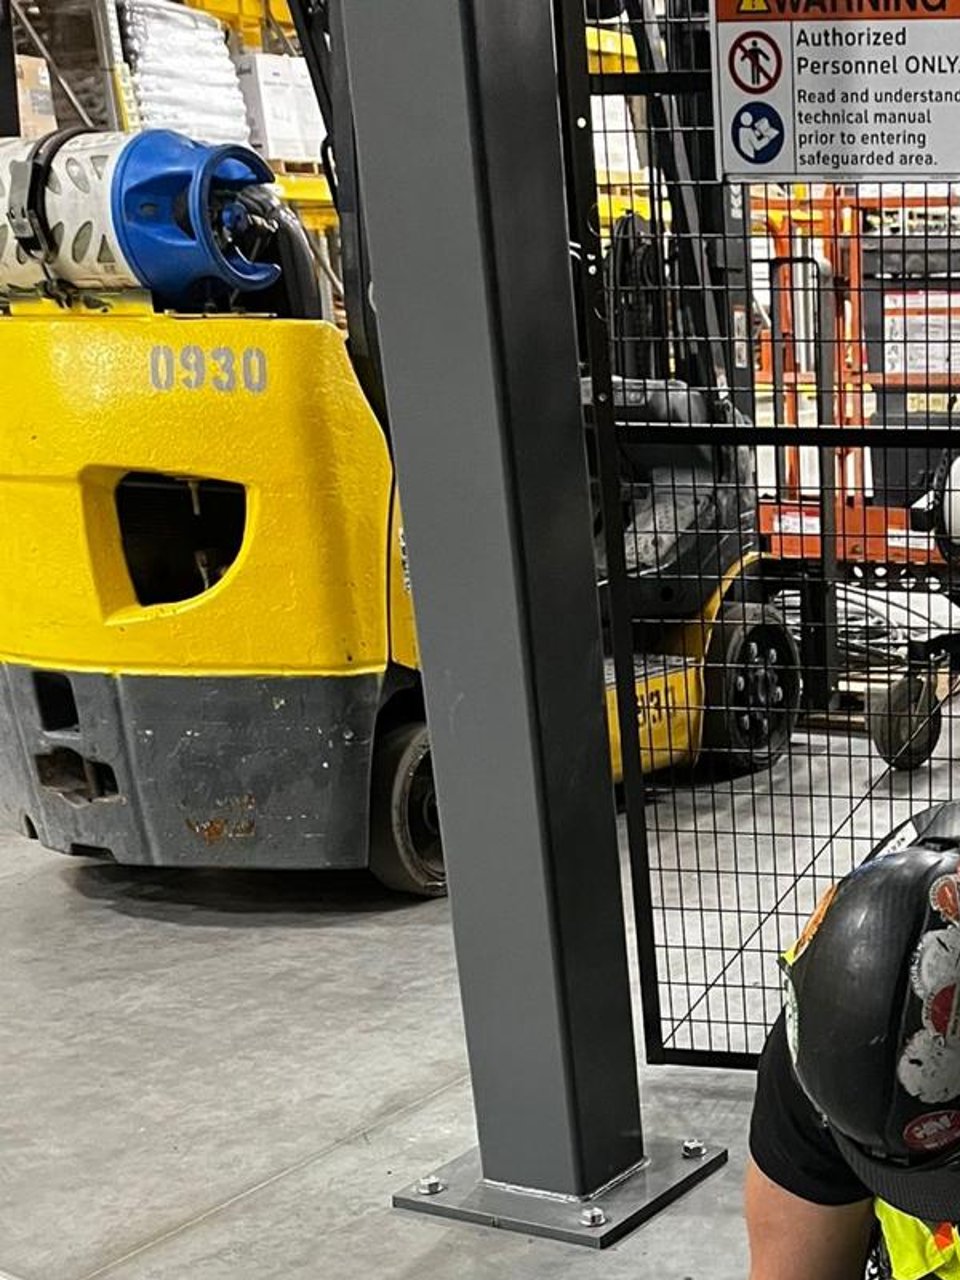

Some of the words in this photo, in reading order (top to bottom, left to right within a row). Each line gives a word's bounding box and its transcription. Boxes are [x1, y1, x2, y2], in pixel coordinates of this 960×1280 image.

[796, 27, 907, 46] Authorized
[796, 56, 898, 75] Personnel
[797, 89, 836, 103] Read
[841, 88, 868, 103] and
[798, 110, 869, 125] technical
[874, 110, 932, 124] manual
[799, 131, 836, 148] prior
[841, 132, 856, 146] to
[861, 130, 926, 147] entering
[799, 151, 895, 169] safeguarded
[899, 154, 938, 166] area.
[151, 345, 267, 392] 0930
